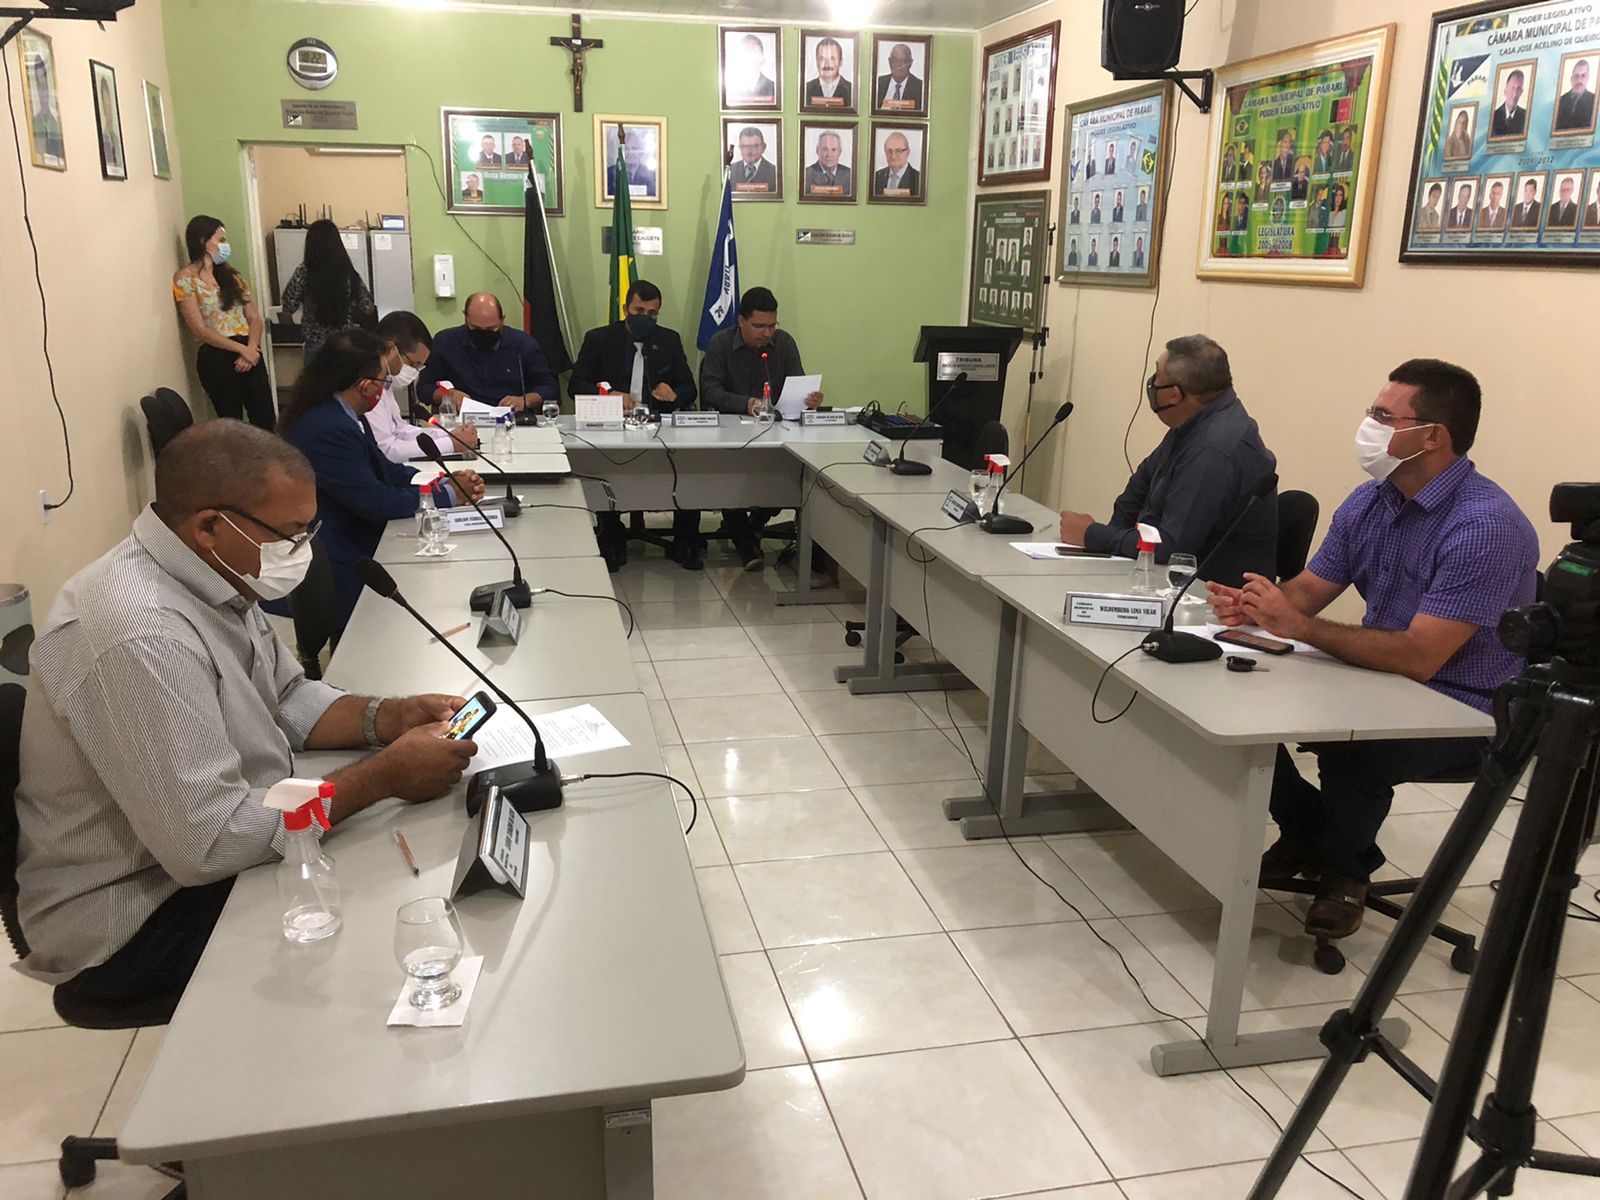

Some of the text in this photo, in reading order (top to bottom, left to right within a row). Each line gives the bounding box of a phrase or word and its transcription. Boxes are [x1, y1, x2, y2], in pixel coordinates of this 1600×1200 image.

[1517, 5, 1593, 25] PODER LEGISLATIVO
[1488, 29, 1524, 46] CÂMARA
[1525, 22, 1573, 39] MUNICIPAL
[1574, 19, 1587, 31] DE
[1533, 38, 1563, 51] ACELINO
[1564, 36, 1573, 46] DE
[1270, 90, 1303, 103] MUNICIPAL
[1260, 100, 1321, 118] PODER LEGISLATIVO
[1100, 111, 1126, 123] MUNICIPAL
[1258, 226, 1295, 237] LEGISLATURA
